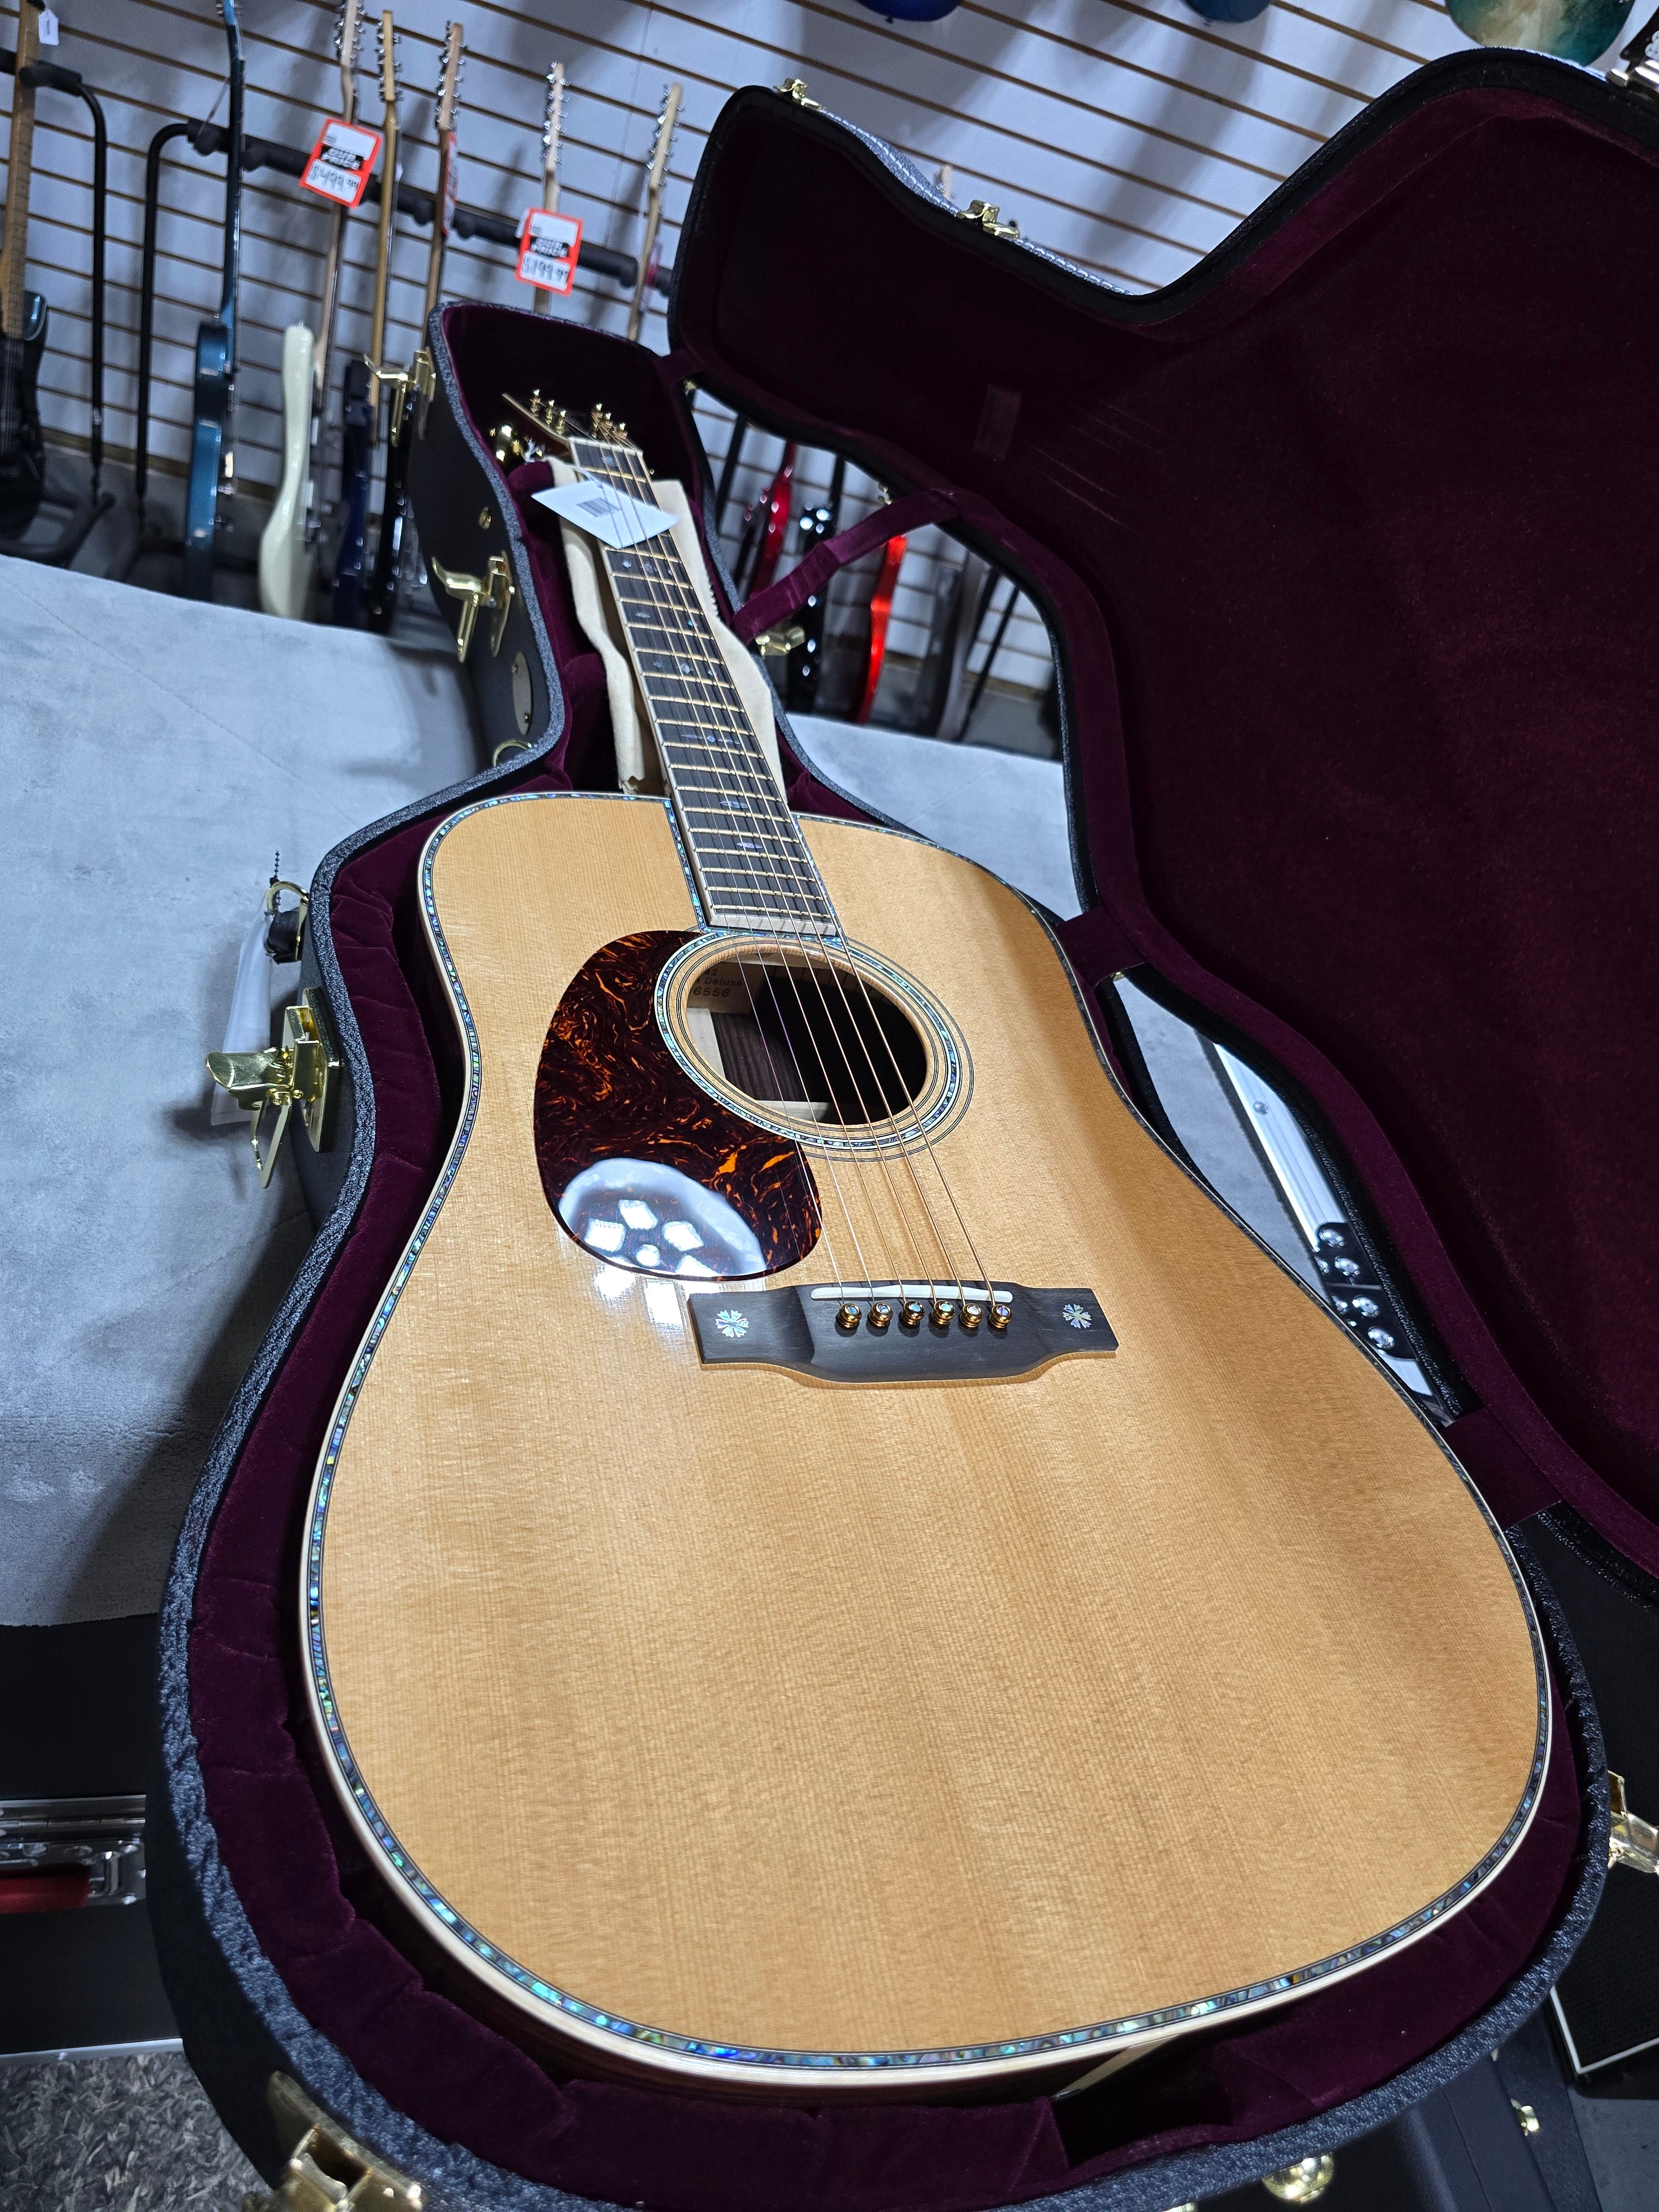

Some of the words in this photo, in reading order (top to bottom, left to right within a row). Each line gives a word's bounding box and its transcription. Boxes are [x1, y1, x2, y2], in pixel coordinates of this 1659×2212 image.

[321, 153, 361, 170] PRICE
[530, 243, 569, 258] PRICE
[705, 977, 743, 987] Deluxe
[693, 987, 731, 998] 6556
